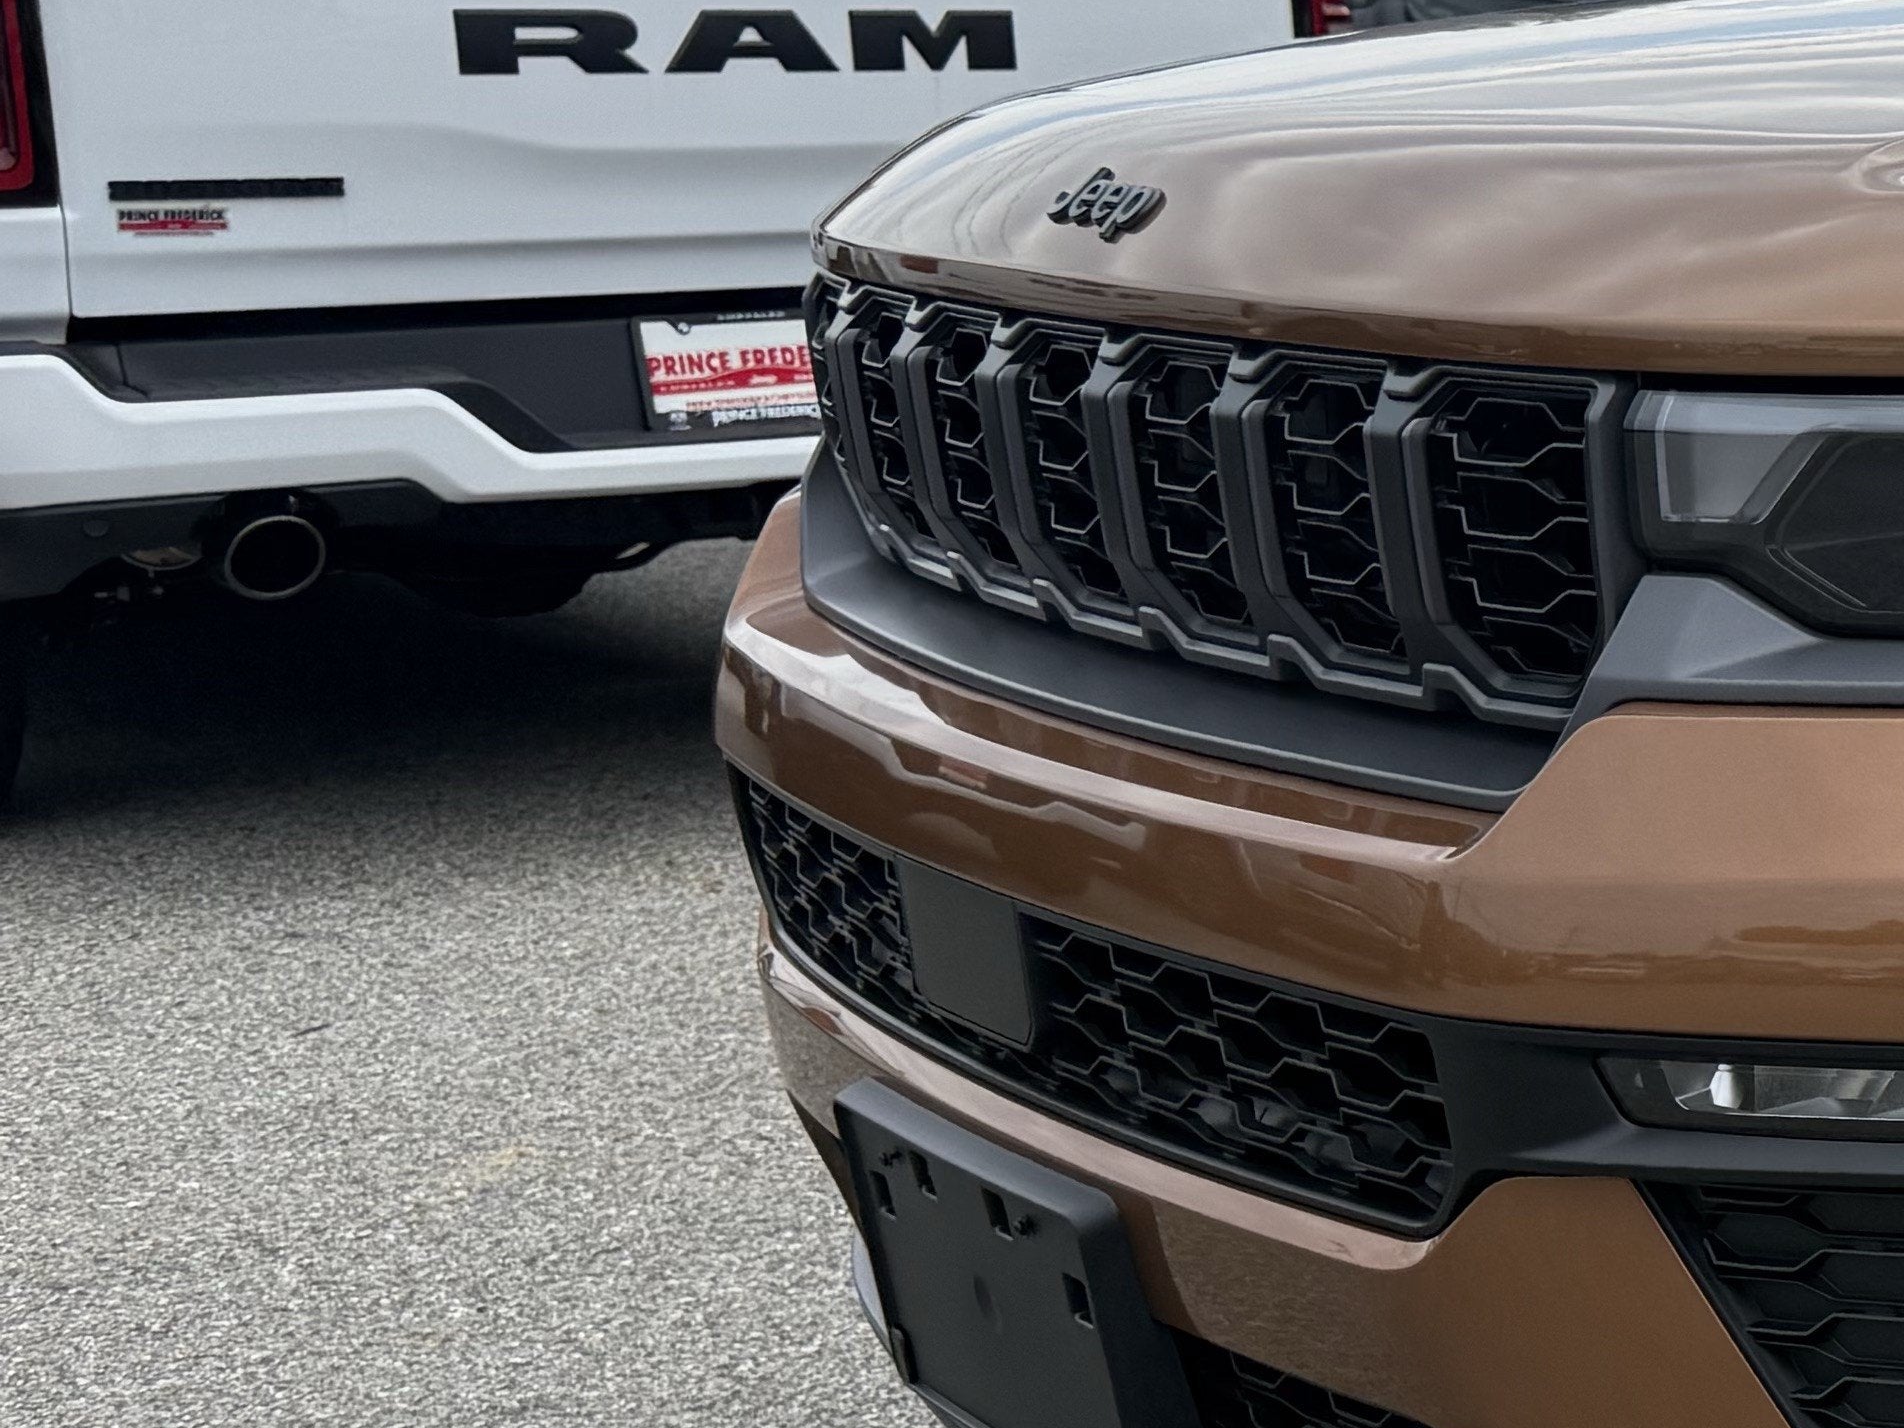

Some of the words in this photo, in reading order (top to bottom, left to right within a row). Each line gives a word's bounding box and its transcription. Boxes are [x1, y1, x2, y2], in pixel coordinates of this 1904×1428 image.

[452, 8, 1017, 75] RAM
[1046, 166, 1167, 244] Jeep
[645, 350, 731, 377] PRINCE
